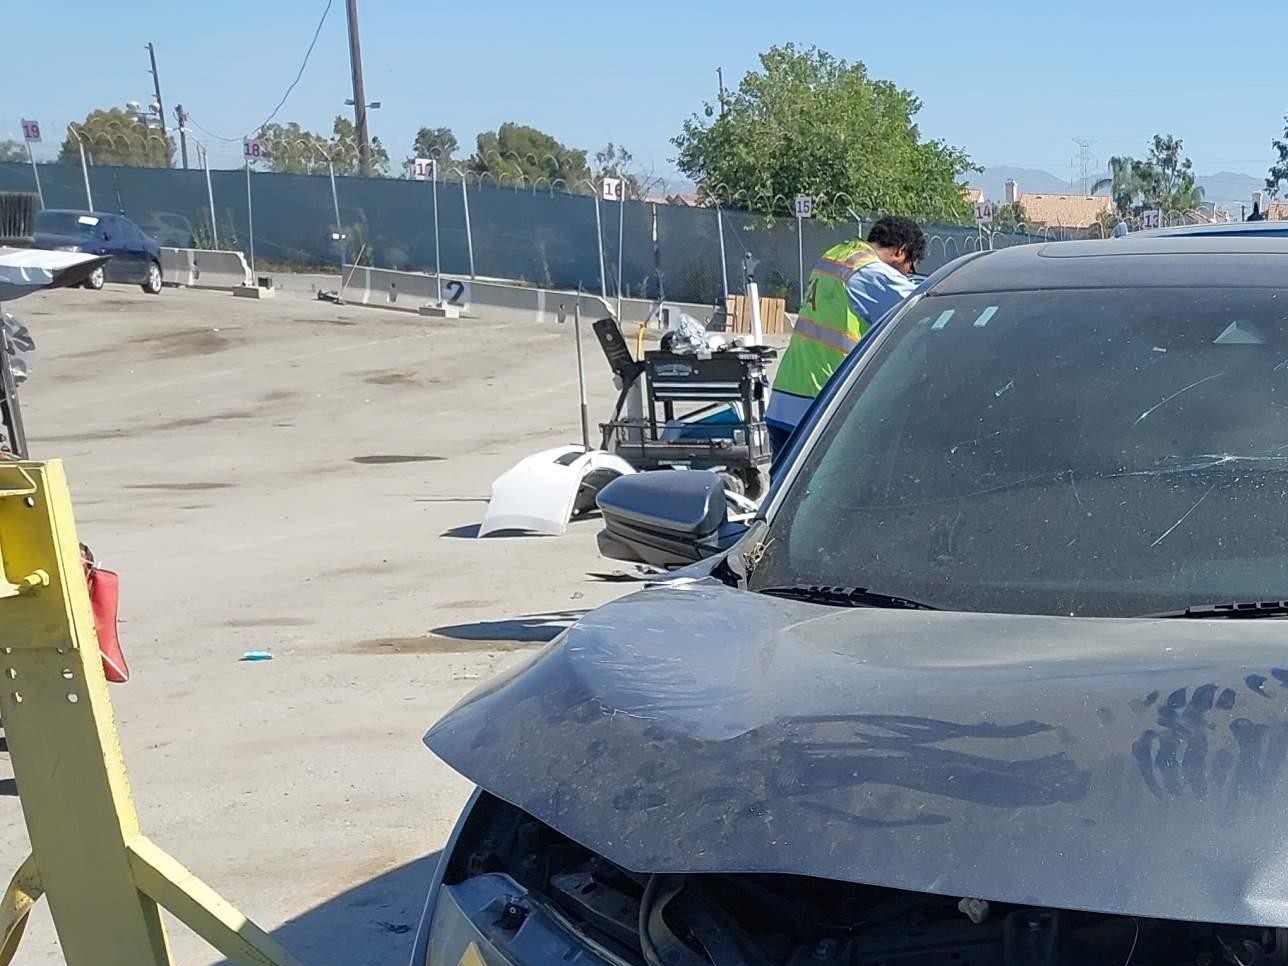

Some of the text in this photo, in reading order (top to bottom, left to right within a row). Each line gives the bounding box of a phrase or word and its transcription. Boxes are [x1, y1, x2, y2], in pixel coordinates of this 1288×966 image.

[23, 125, 40, 139] 19
[244, 143, 261, 157] 18
[416, 163, 433, 177] 17
[605, 183, 622, 198] 16
[796, 200, 810, 214] 15
[976, 205, 991, 220] 14
[446, 280, 465, 307] 2
